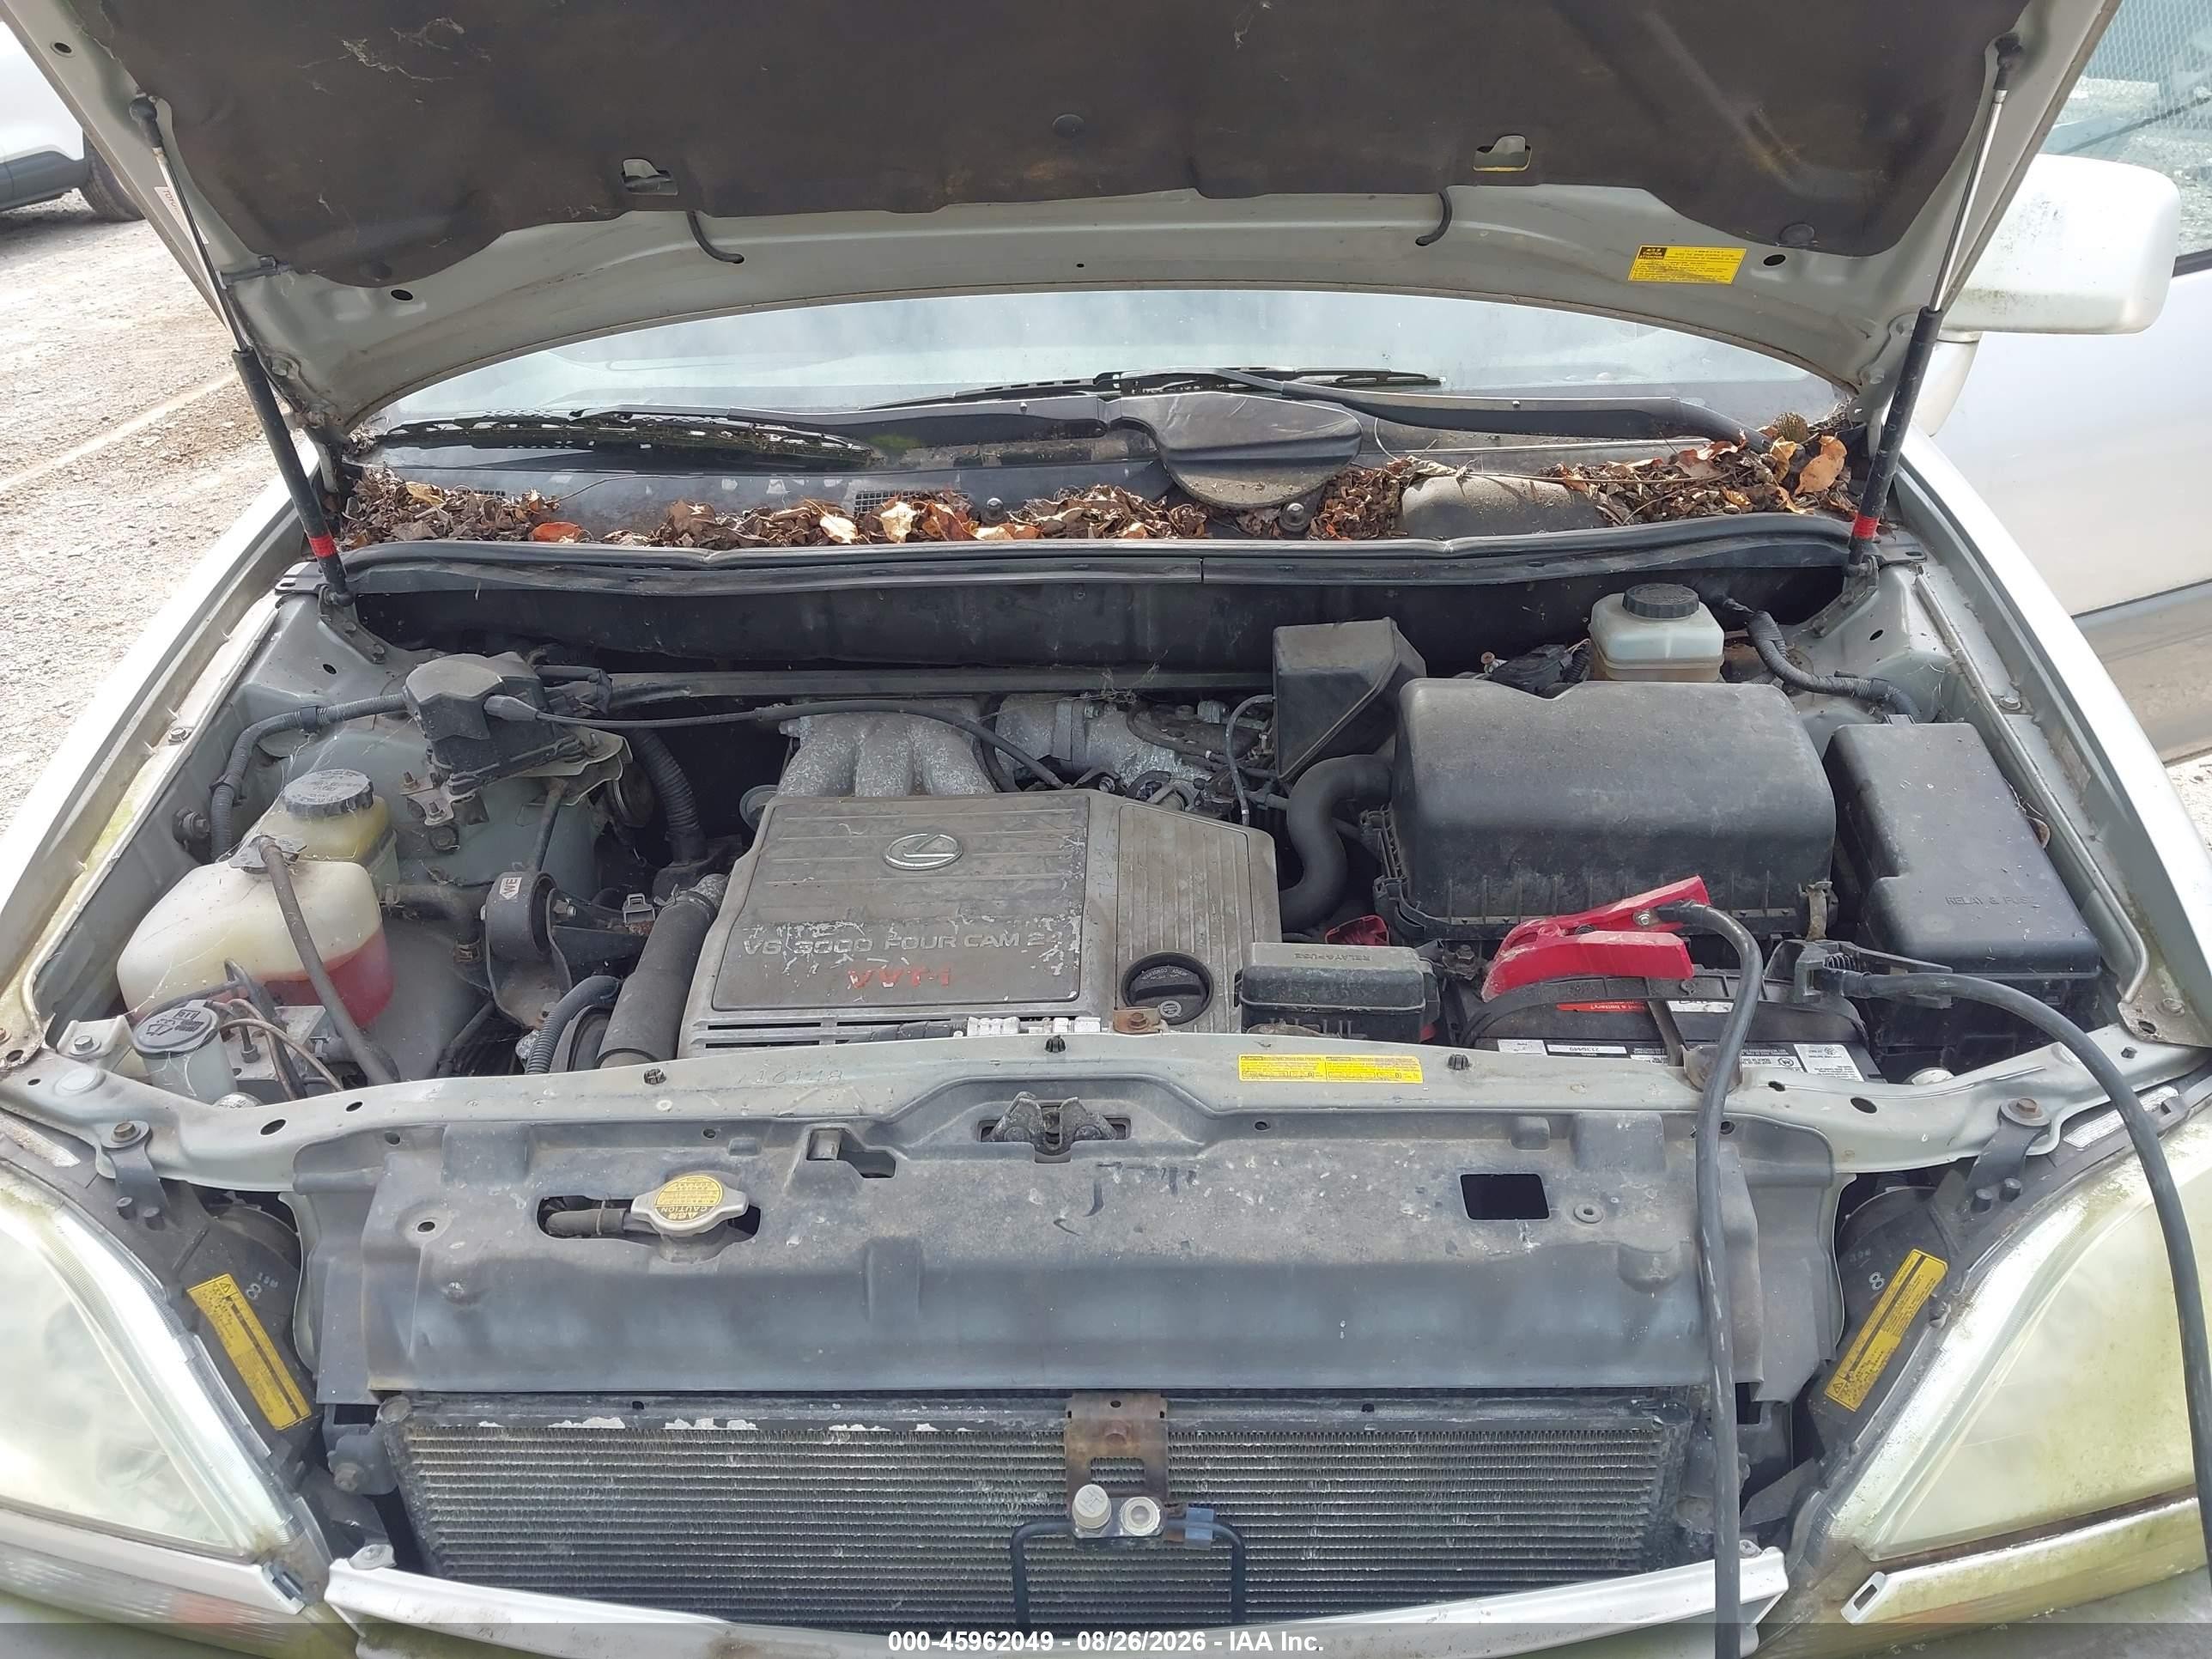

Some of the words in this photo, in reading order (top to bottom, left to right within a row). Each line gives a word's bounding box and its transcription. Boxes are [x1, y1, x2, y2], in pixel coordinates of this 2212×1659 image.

[743, 939, 782, 955] V6
[793, 938, 873, 954] 3000
[884, 934, 957, 951] FOUR
[963, 933, 1020, 948] CAM
